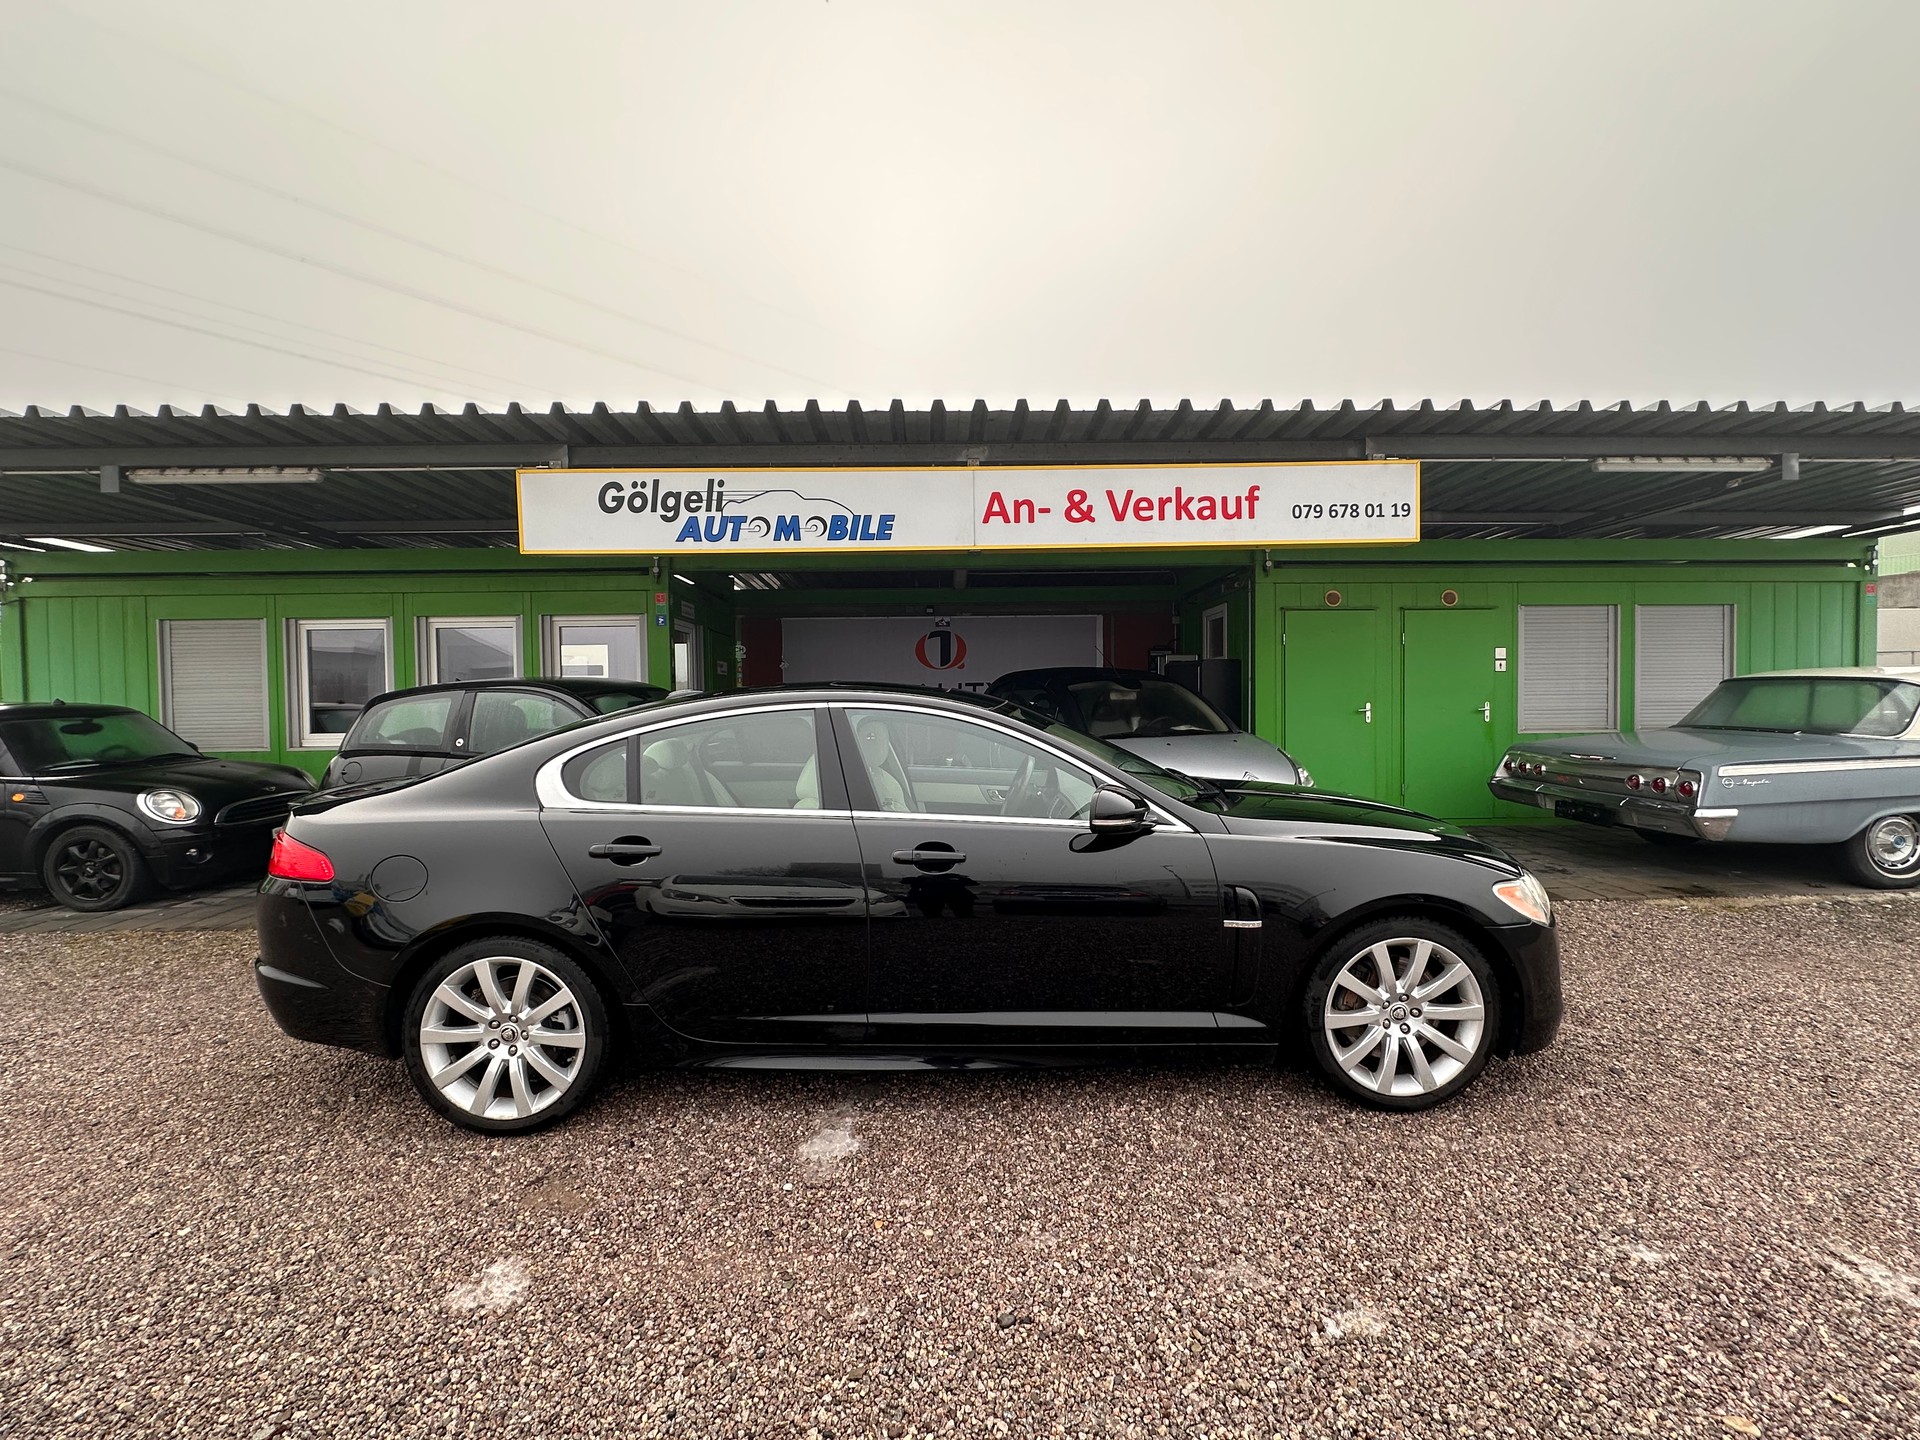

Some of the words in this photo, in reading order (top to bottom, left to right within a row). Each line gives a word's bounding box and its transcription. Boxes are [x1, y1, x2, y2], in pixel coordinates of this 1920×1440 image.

[598, 478, 725, 523] Gölgeli
[982, 491, 1051, 524] An-
[1064, 489, 1096, 523] &
[1105, 485, 1260, 522] Verkauf
[1292, 504, 1323, 519] 079
[1328, 503, 1360, 518] 678
[1364, 503, 1385, 518] 01
[1391, 502, 1411, 518] 19
